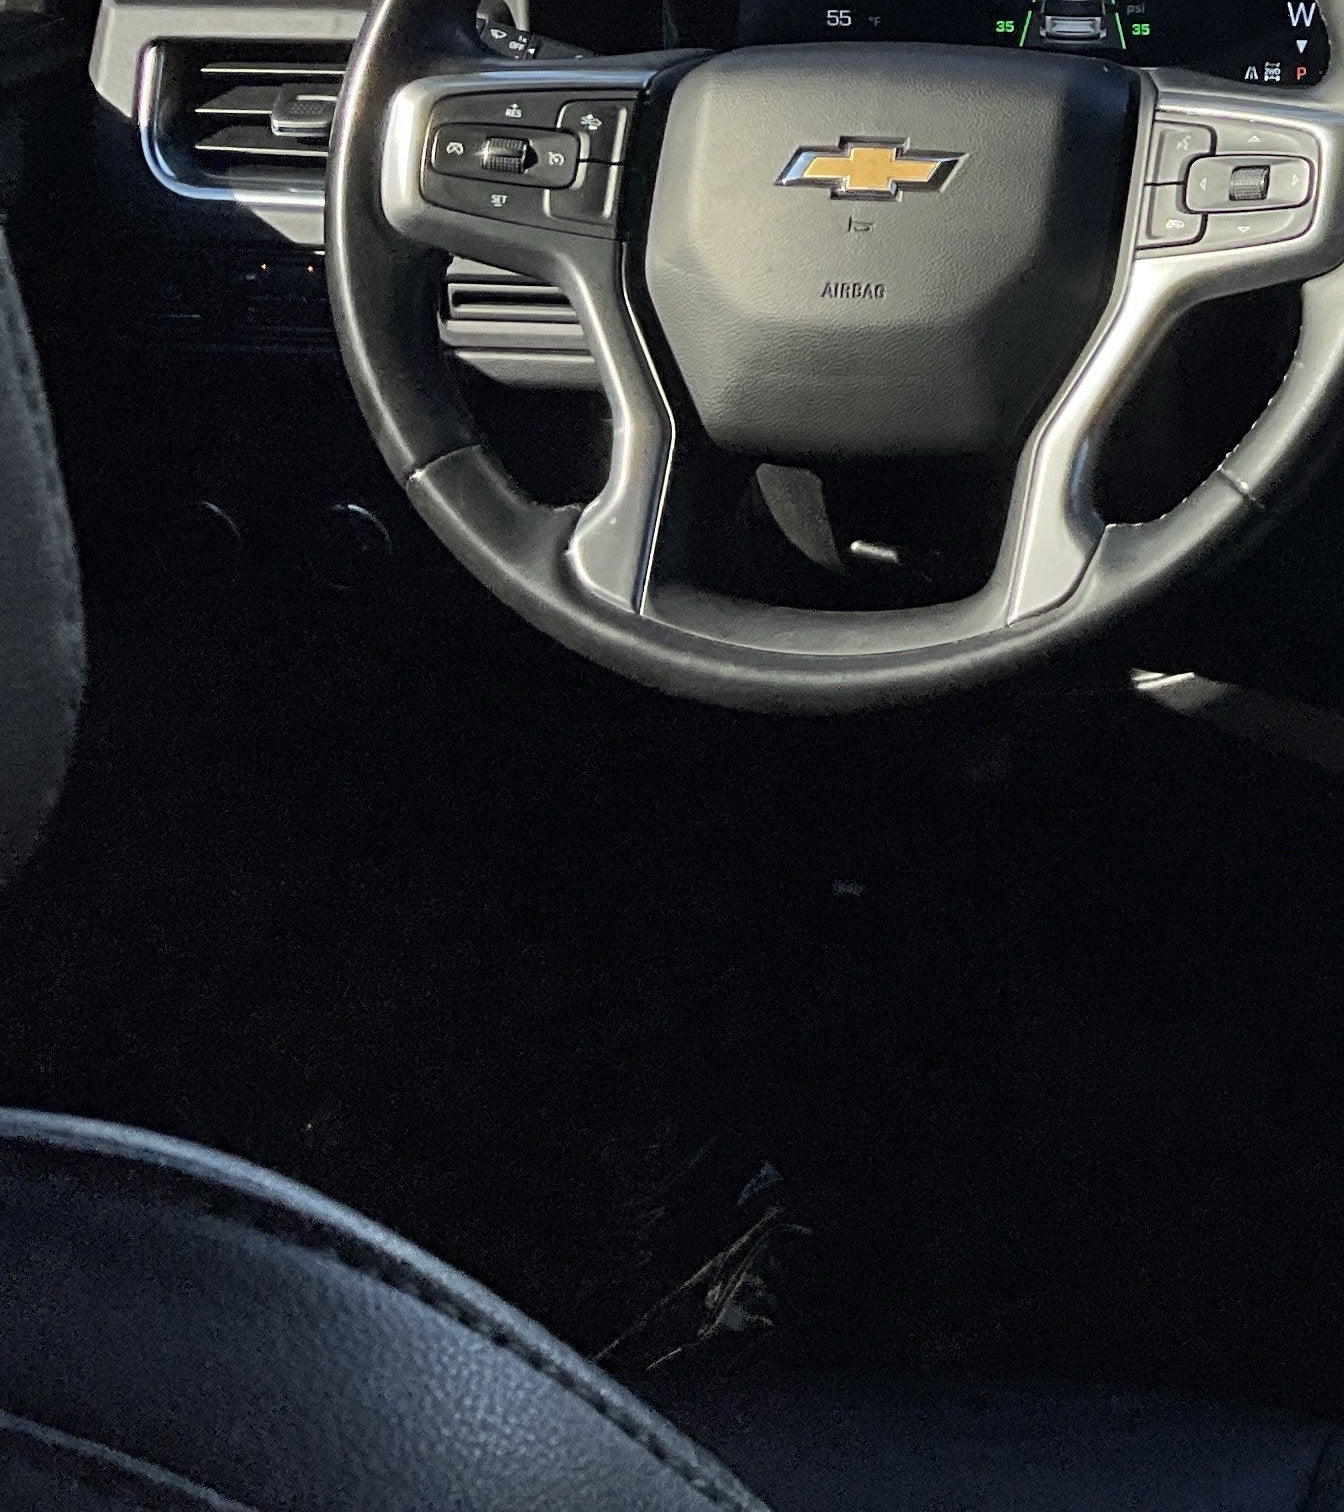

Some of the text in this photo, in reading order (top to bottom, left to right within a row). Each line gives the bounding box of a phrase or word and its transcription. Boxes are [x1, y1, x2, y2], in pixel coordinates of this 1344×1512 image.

[1126, 2, 1146, 15] psi
[1287, 1, 1317, 27] W
[826, 9, 852, 27] 55
[995, 20, 1015, 33] 35
[1131, 23, 1151, 36] 35
[1296, 66, 1308, 81] P
[820, 282, 886, 300] AIRBAG
